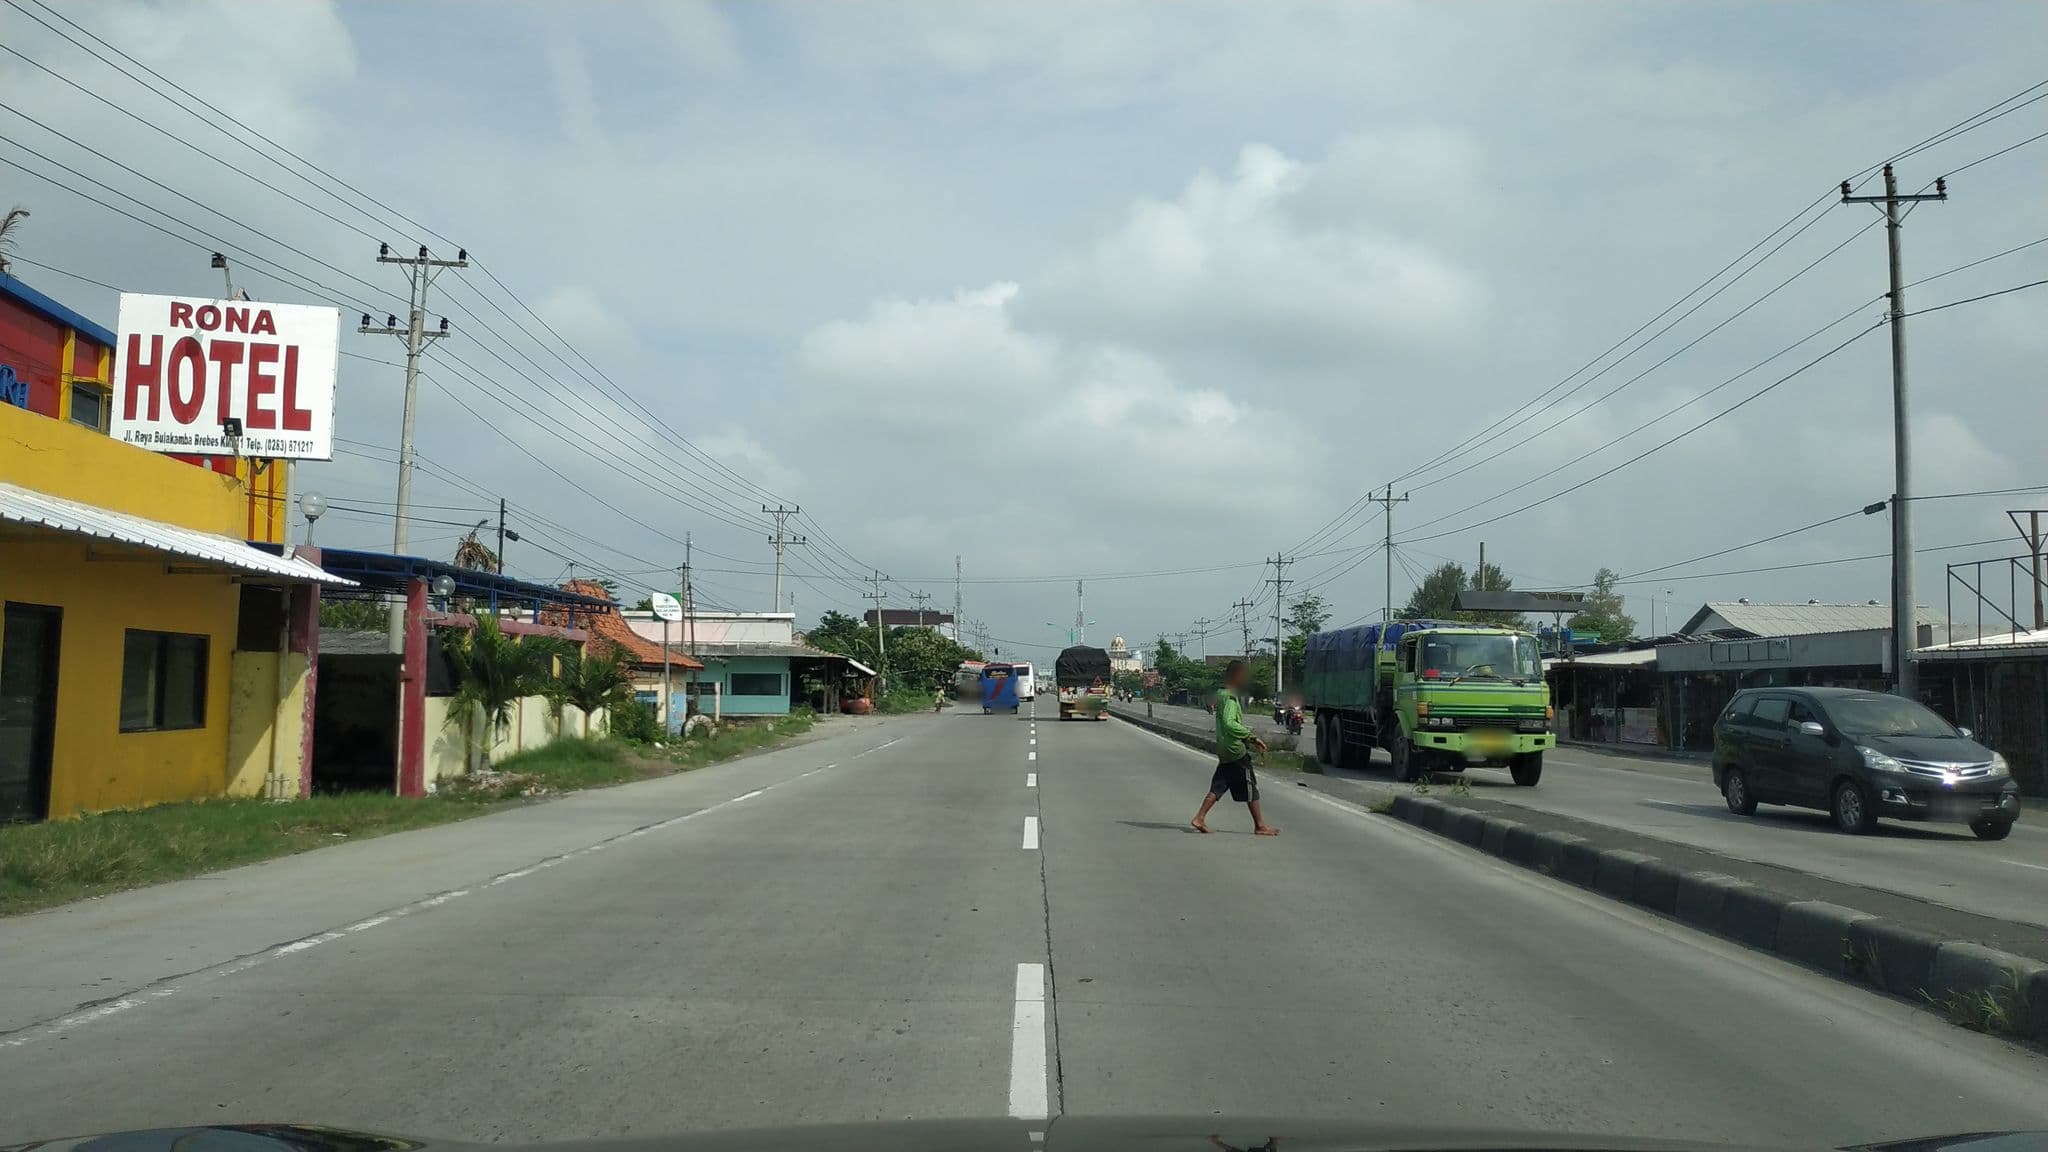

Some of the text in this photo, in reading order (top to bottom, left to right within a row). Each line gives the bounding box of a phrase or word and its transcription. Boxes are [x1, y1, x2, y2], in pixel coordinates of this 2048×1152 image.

[170, 302, 277, 335] RONA
[123, 333, 312, 431] HOTEL
[135, 430, 152, 446] Raya
[154, 431, 193, 446] Bulakamba
[194, 433, 219, 447] Brebes
[246, 437, 263, 453] Telp.
